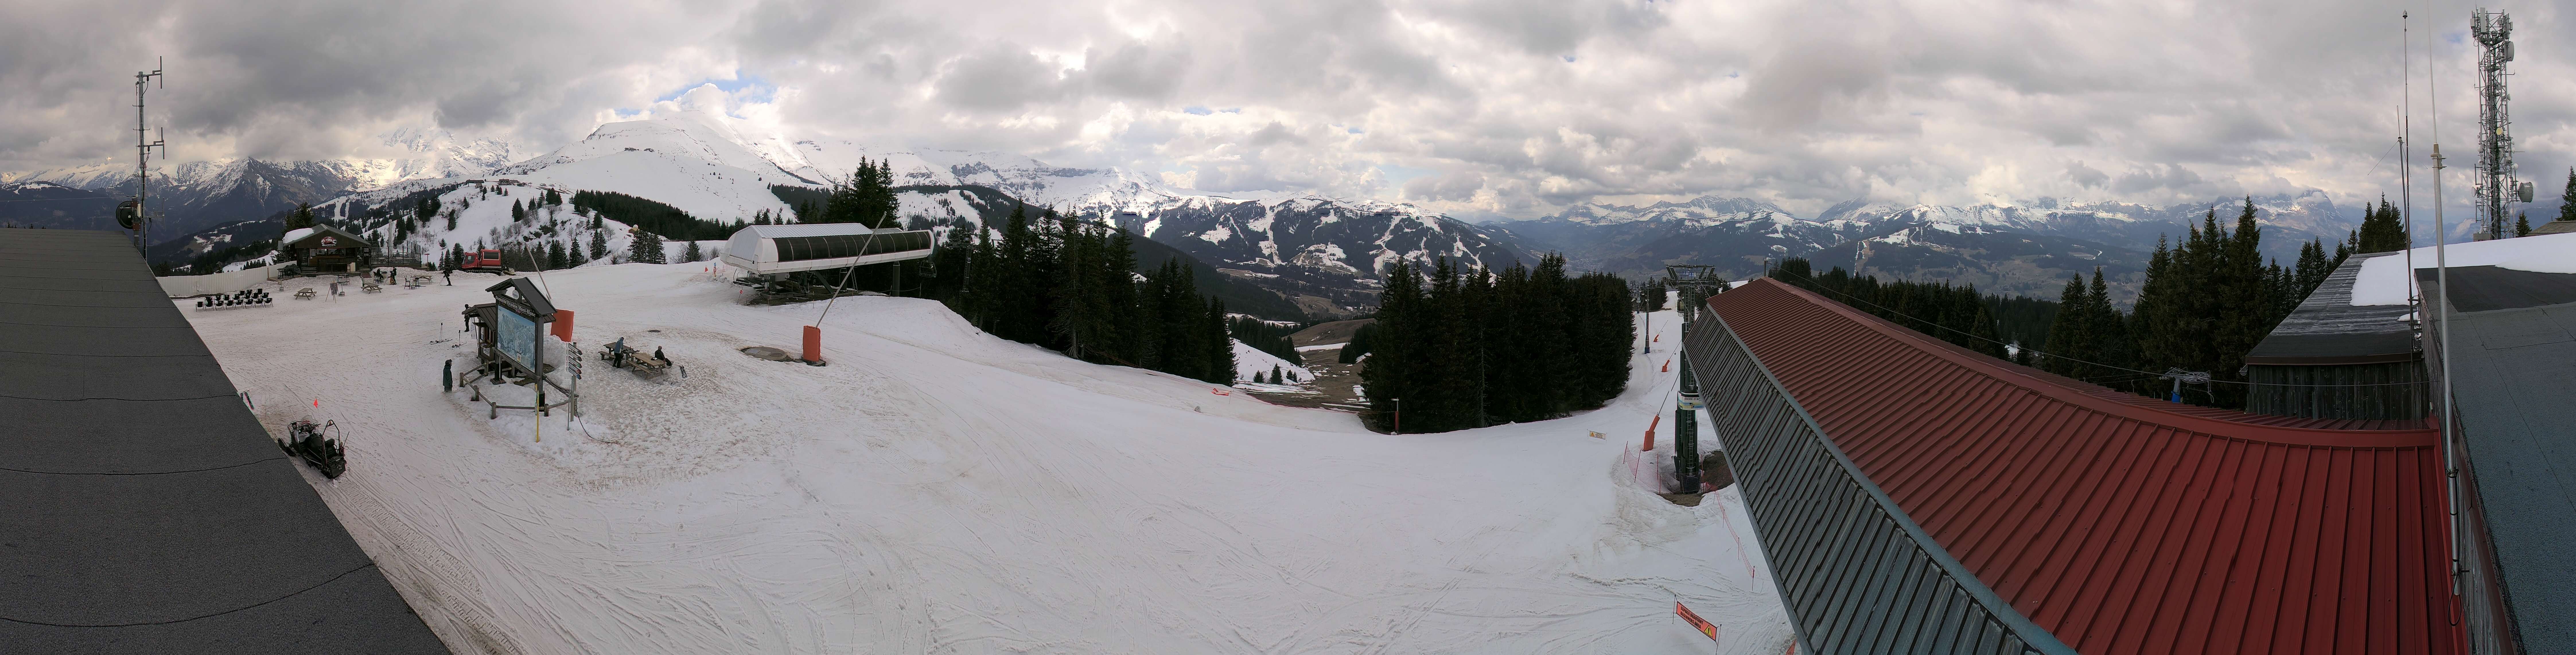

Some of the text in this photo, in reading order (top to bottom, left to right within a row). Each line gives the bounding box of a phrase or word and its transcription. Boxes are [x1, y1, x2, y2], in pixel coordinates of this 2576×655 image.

[496, 296, 507, 304] Domaine
[507, 301, 517, 310] Evasion
[518, 306, 536, 317] Mont-Blanc
